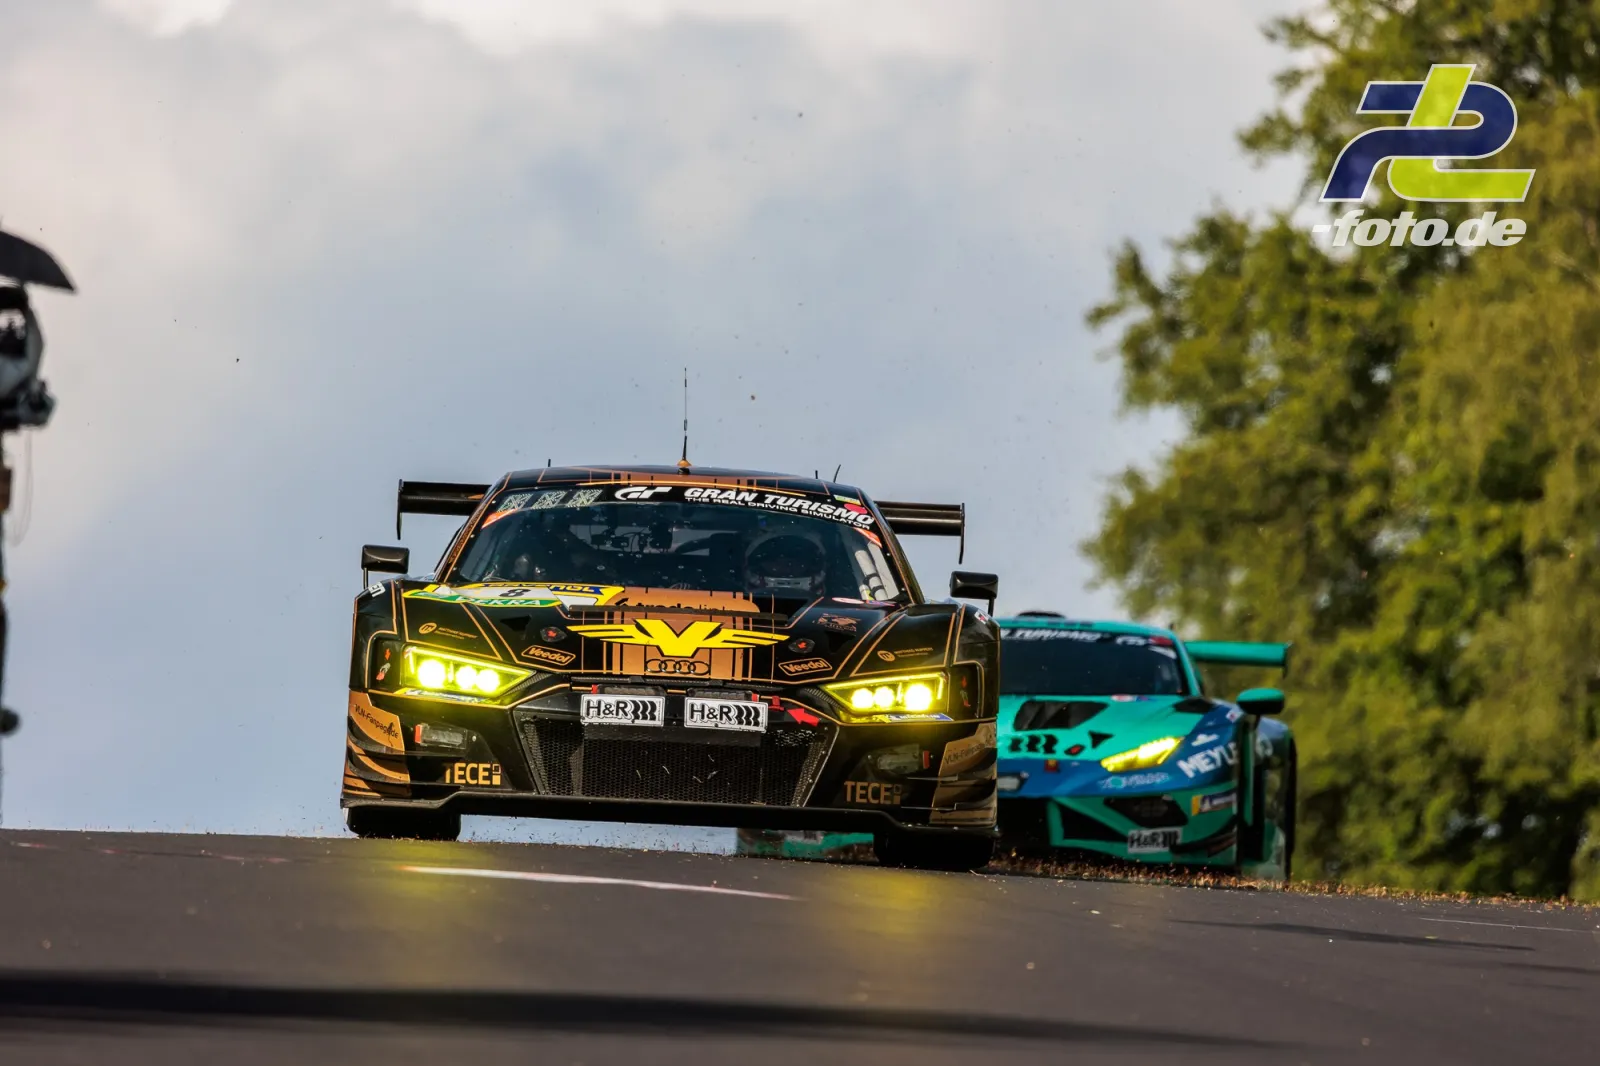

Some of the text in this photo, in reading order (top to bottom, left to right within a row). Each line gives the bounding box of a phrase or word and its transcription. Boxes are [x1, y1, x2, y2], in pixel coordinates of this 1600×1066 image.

[684, 487, 875, 525] GRAN TURISMO
[713, 498, 745, 506] REAL
[748, 501, 798, 513] DRIVING
[801, 508, 870, 530] SIMULATOR
[455, 596, 541, 606] DEKRA
[500, 588, 532, 598] 8
[527, 646, 571, 663] Veedol
[782, 659, 828, 673] Veedol
[586, 699, 630, 718] H&R
[690, 703, 733, 722] H&R
[844, 781, 892, 805] TECE
